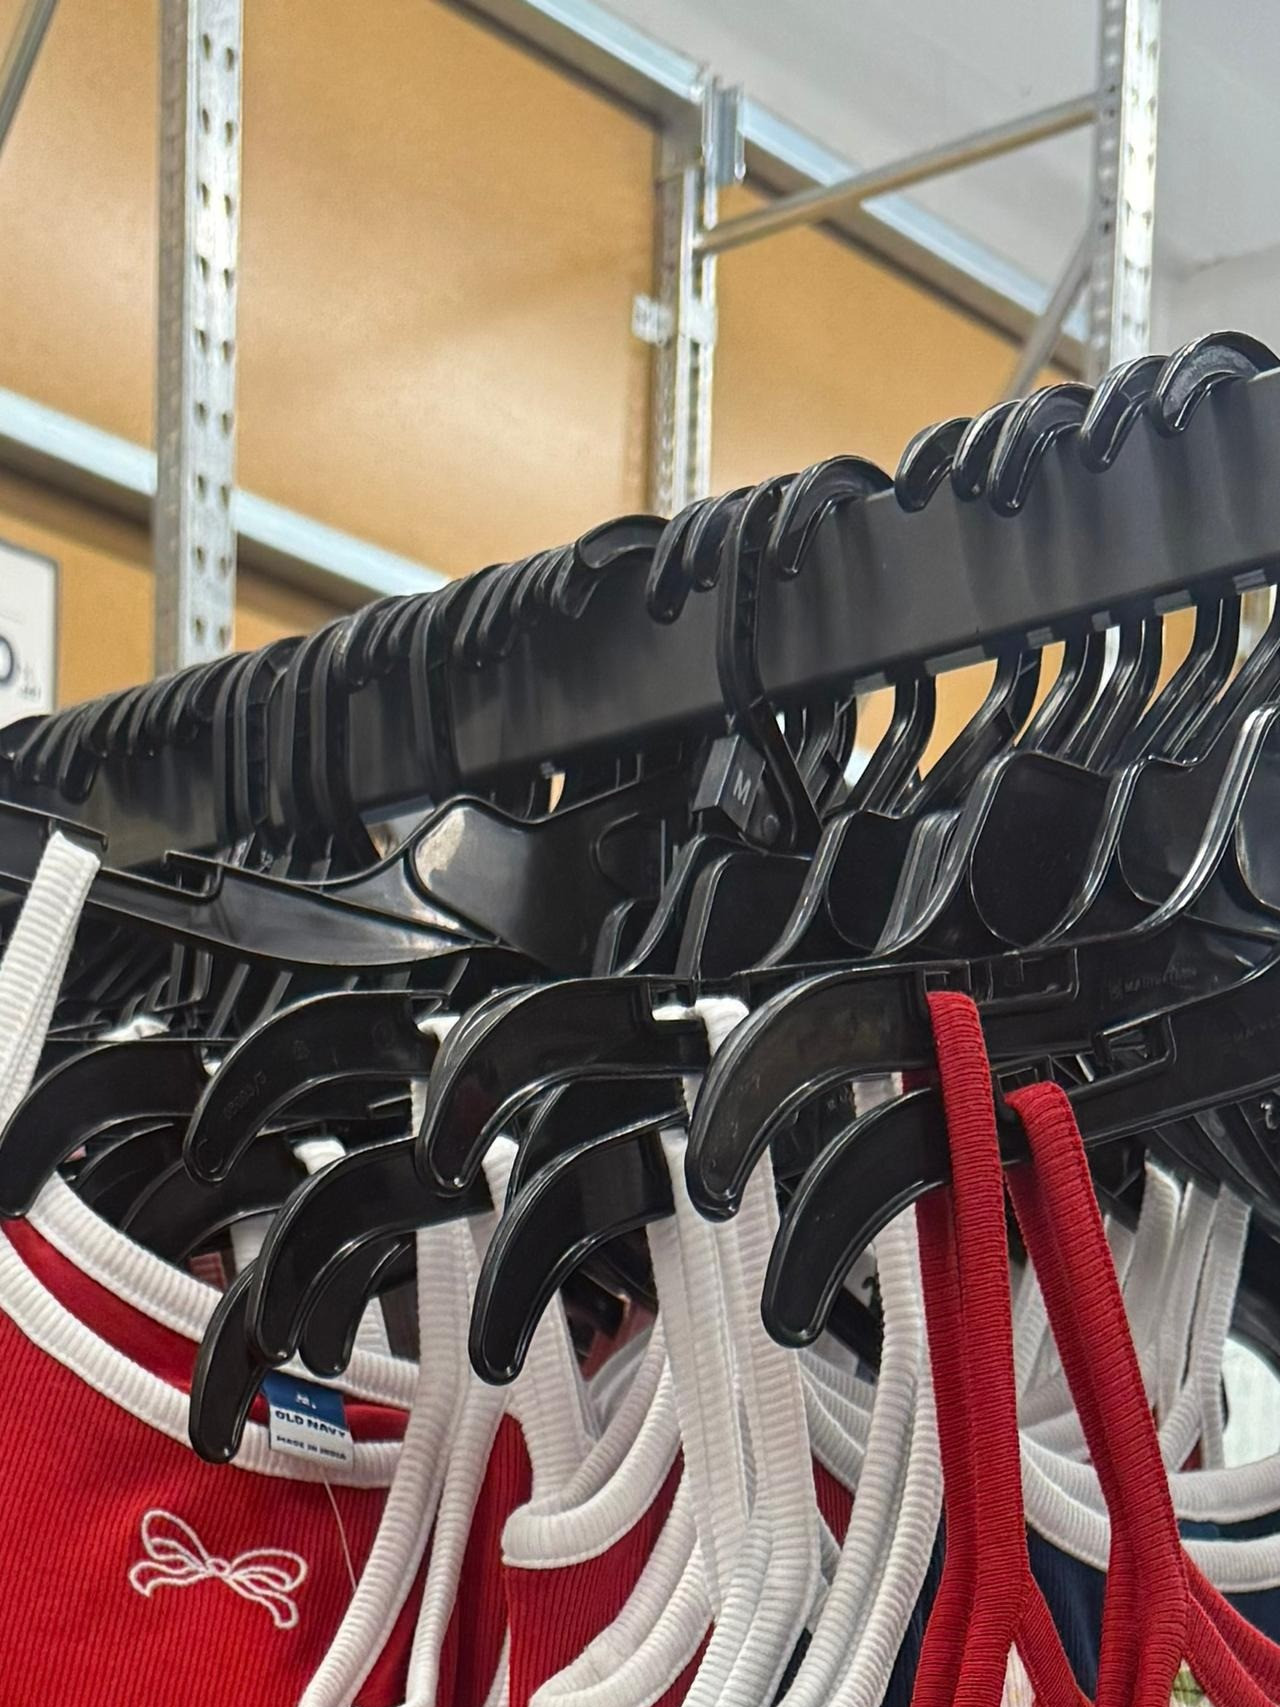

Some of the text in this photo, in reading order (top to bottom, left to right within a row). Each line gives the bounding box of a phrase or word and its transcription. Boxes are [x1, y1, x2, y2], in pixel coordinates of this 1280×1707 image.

[275, 1410, 346, 1438] OLD NAVY
[276, 1435, 304, 1449] MADE
